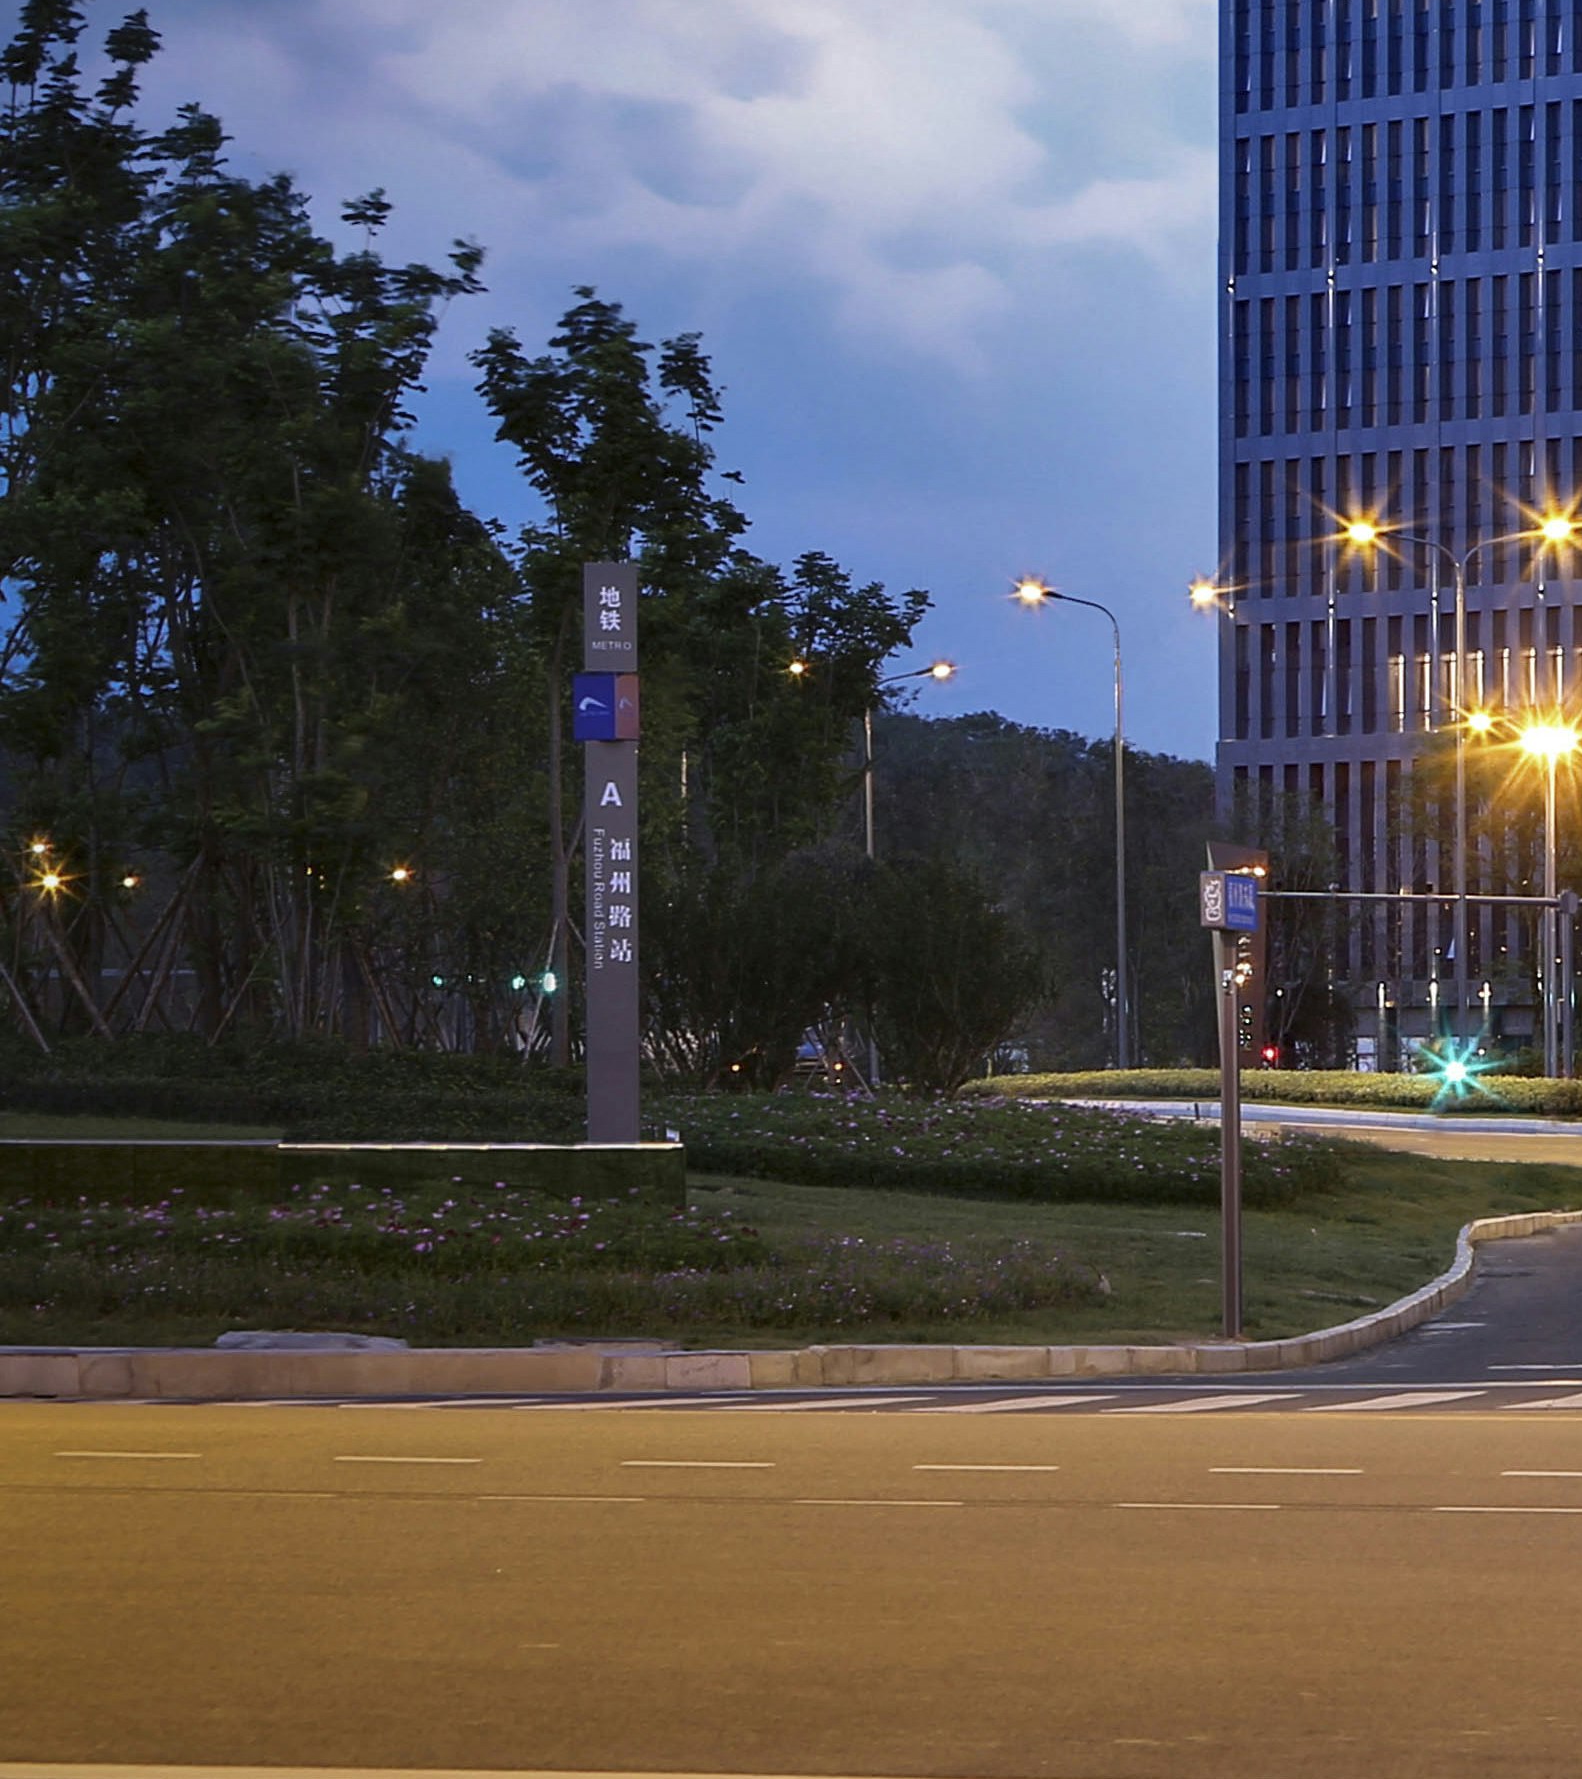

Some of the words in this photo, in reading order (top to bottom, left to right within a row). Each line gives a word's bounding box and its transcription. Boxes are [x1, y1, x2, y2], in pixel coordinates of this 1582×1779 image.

[599, 586, 621, 631] 地铁
[592, 641, 632, 650] METRO
[601, 782, 622, 807] A
[593, 828, 605, 879] Fuzhou
[594, 881, 605, 918] Road
[608, 837, 632, 962] 福州路站
[593, 921, 606, 969] Station
